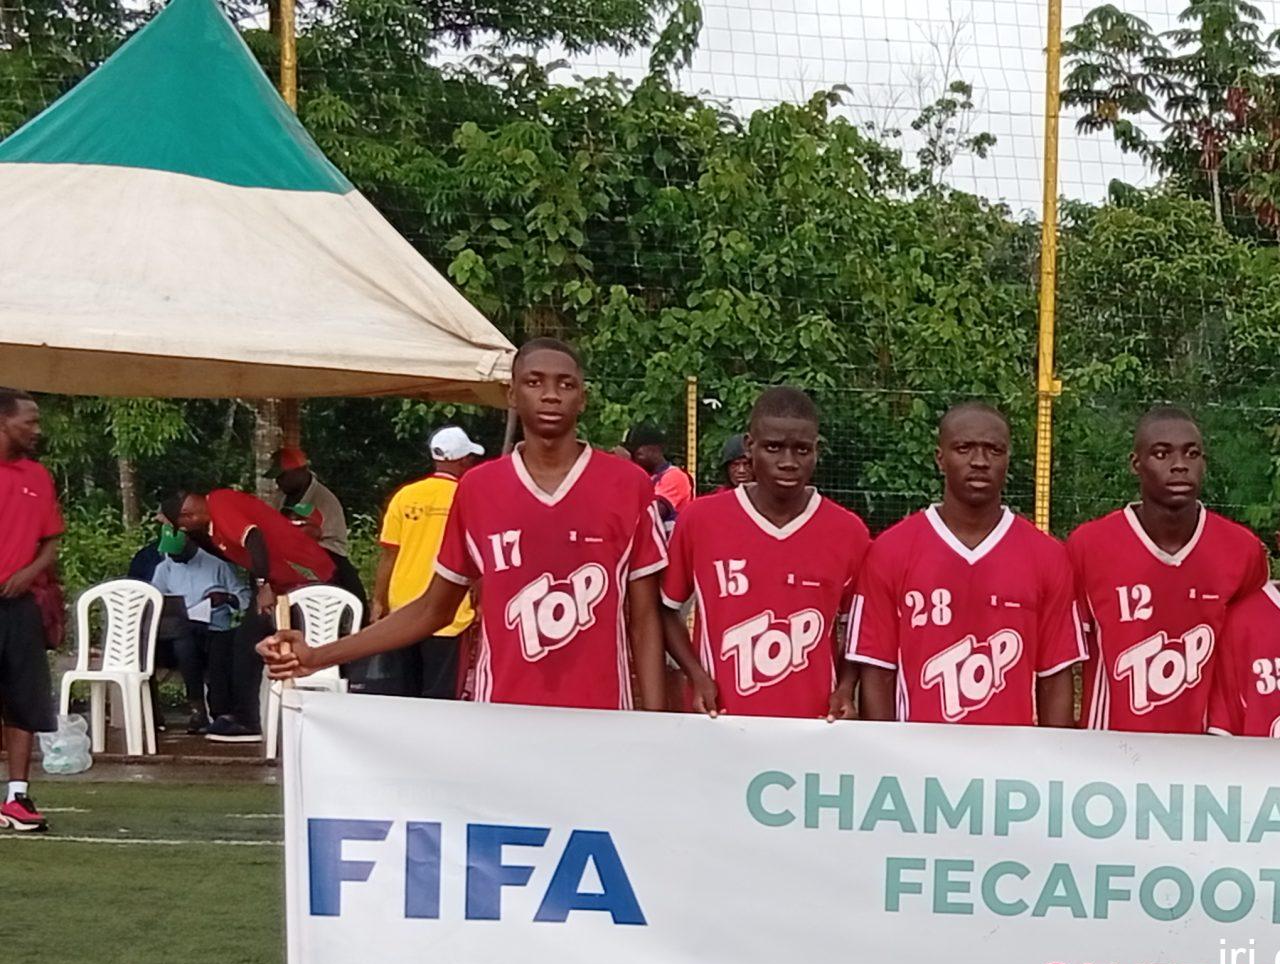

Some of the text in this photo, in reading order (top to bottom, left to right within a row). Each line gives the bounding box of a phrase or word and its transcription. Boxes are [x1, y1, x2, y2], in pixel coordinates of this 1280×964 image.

[488, 529, 522, 572] 17
[712, 558, 749, 597] 15
[505, 562, 609, 662] TOP
[905, 587, 952, 627] 28
[1115, 583, 1152, 622] 12
[720, 607, 825, 697] TOP
[920, 628, 1023, 722] TOP
[1113, 623, 1215, 716] TOP
[307, 818, 648, 926] FIFA
